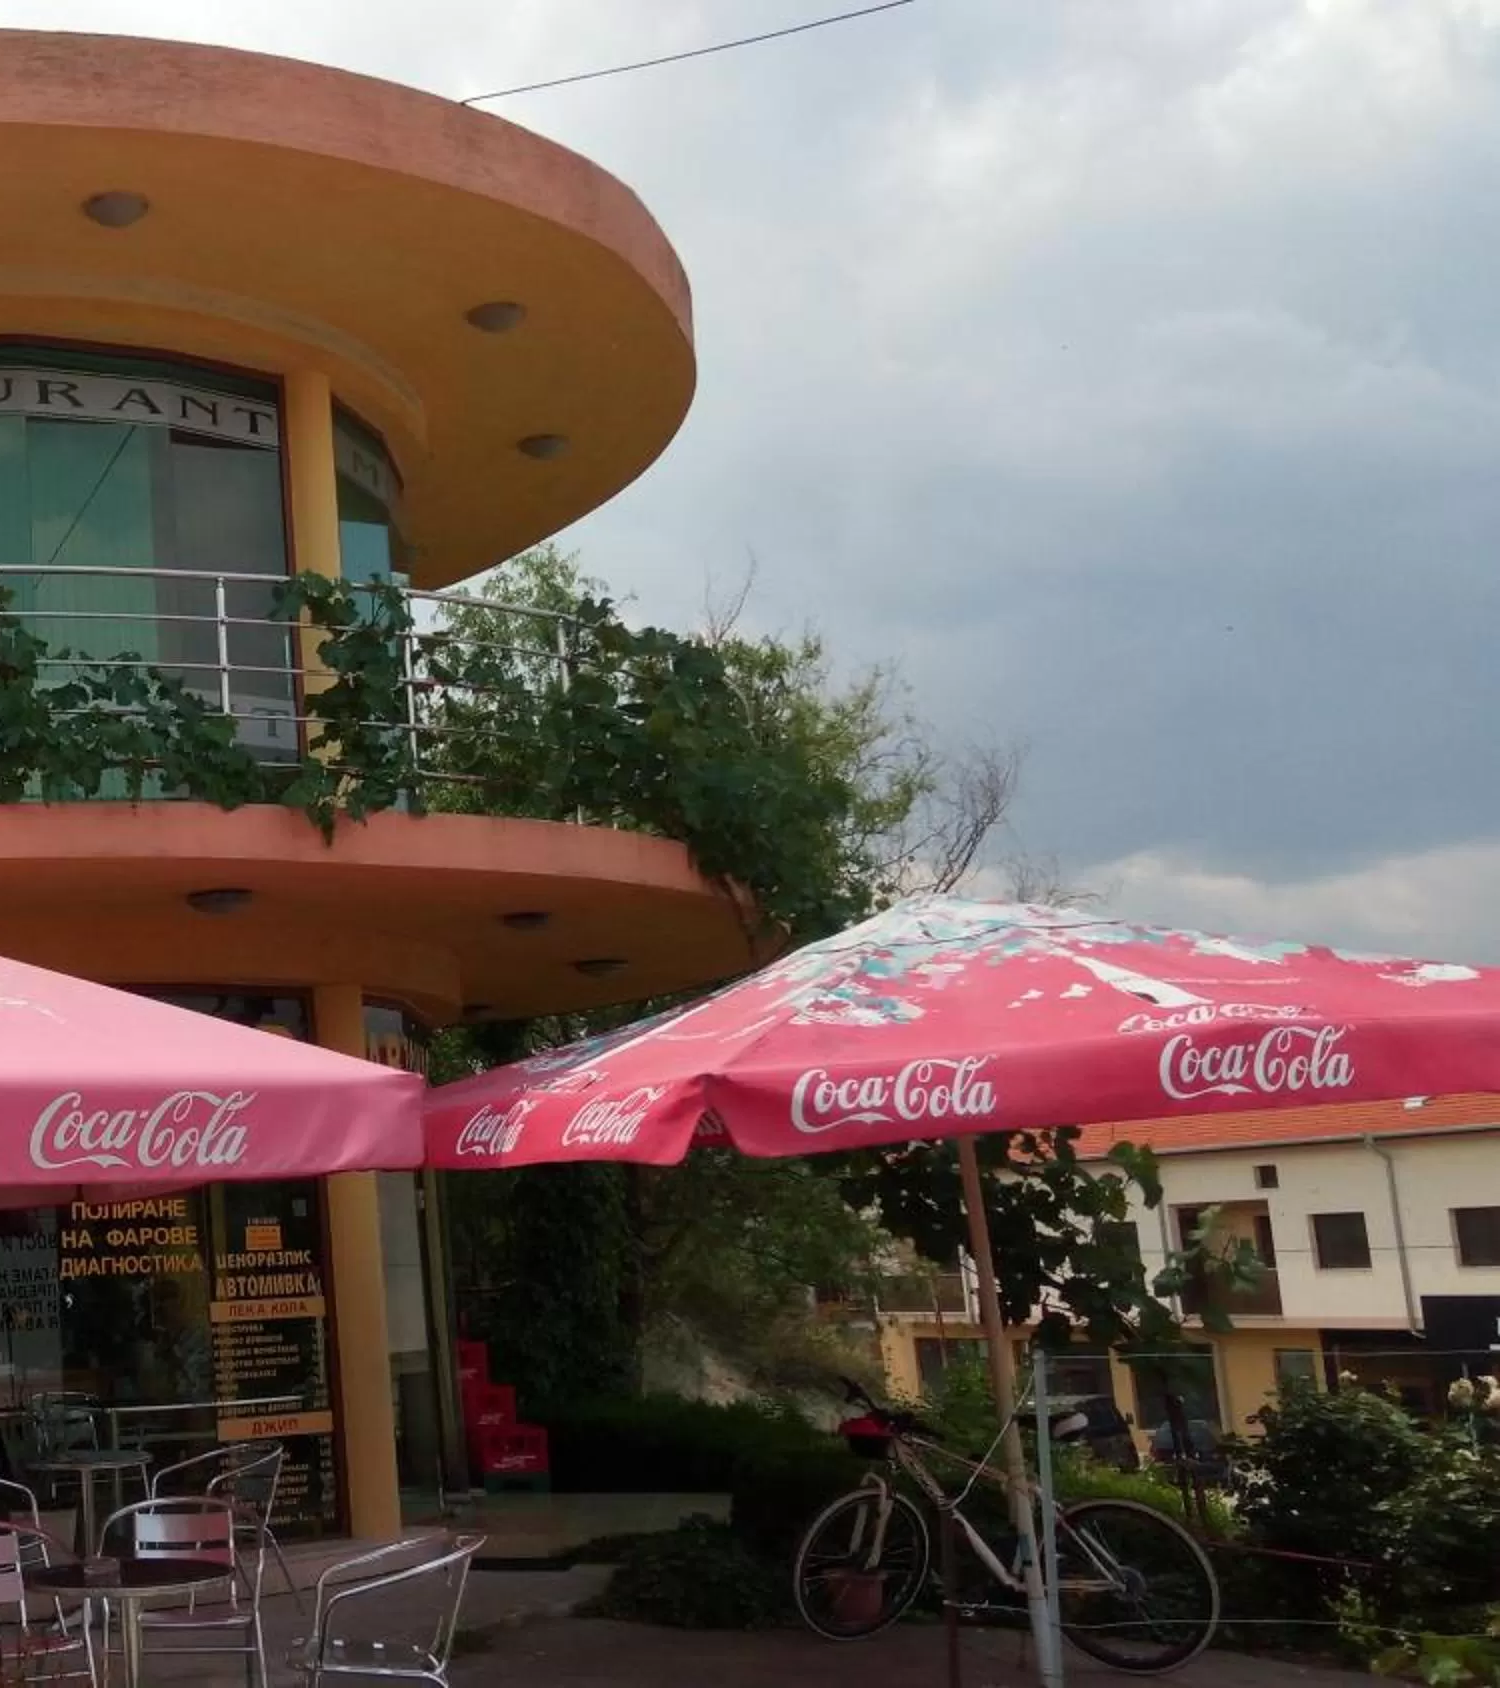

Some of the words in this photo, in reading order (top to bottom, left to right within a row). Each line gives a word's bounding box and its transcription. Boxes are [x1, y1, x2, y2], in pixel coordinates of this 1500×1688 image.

[1158, 1024, 1356, 1101] Coca-Cola
[790, 1054, 998, 1134] Coca-Cola
[29, 1090, 258, 1169] Coca-Cola
[71, 1199, 188, 1222] ПОЛИРАНЕ
[60, 1228, 94, 1249] НА
[105, 1225, 199, 1248] ФАРОВЕ
[59, 1253, 204, 1281] ДИАГНОСТИКА
[215, 1249, 312, 1270] ЦЕНОРАЗПИС
[215, 1272, 318, 1299] АВТОМИВКА
[270, 1301, 308, 1316] КОЛА
[251, 1419, 298, 1436] ДЖИП
